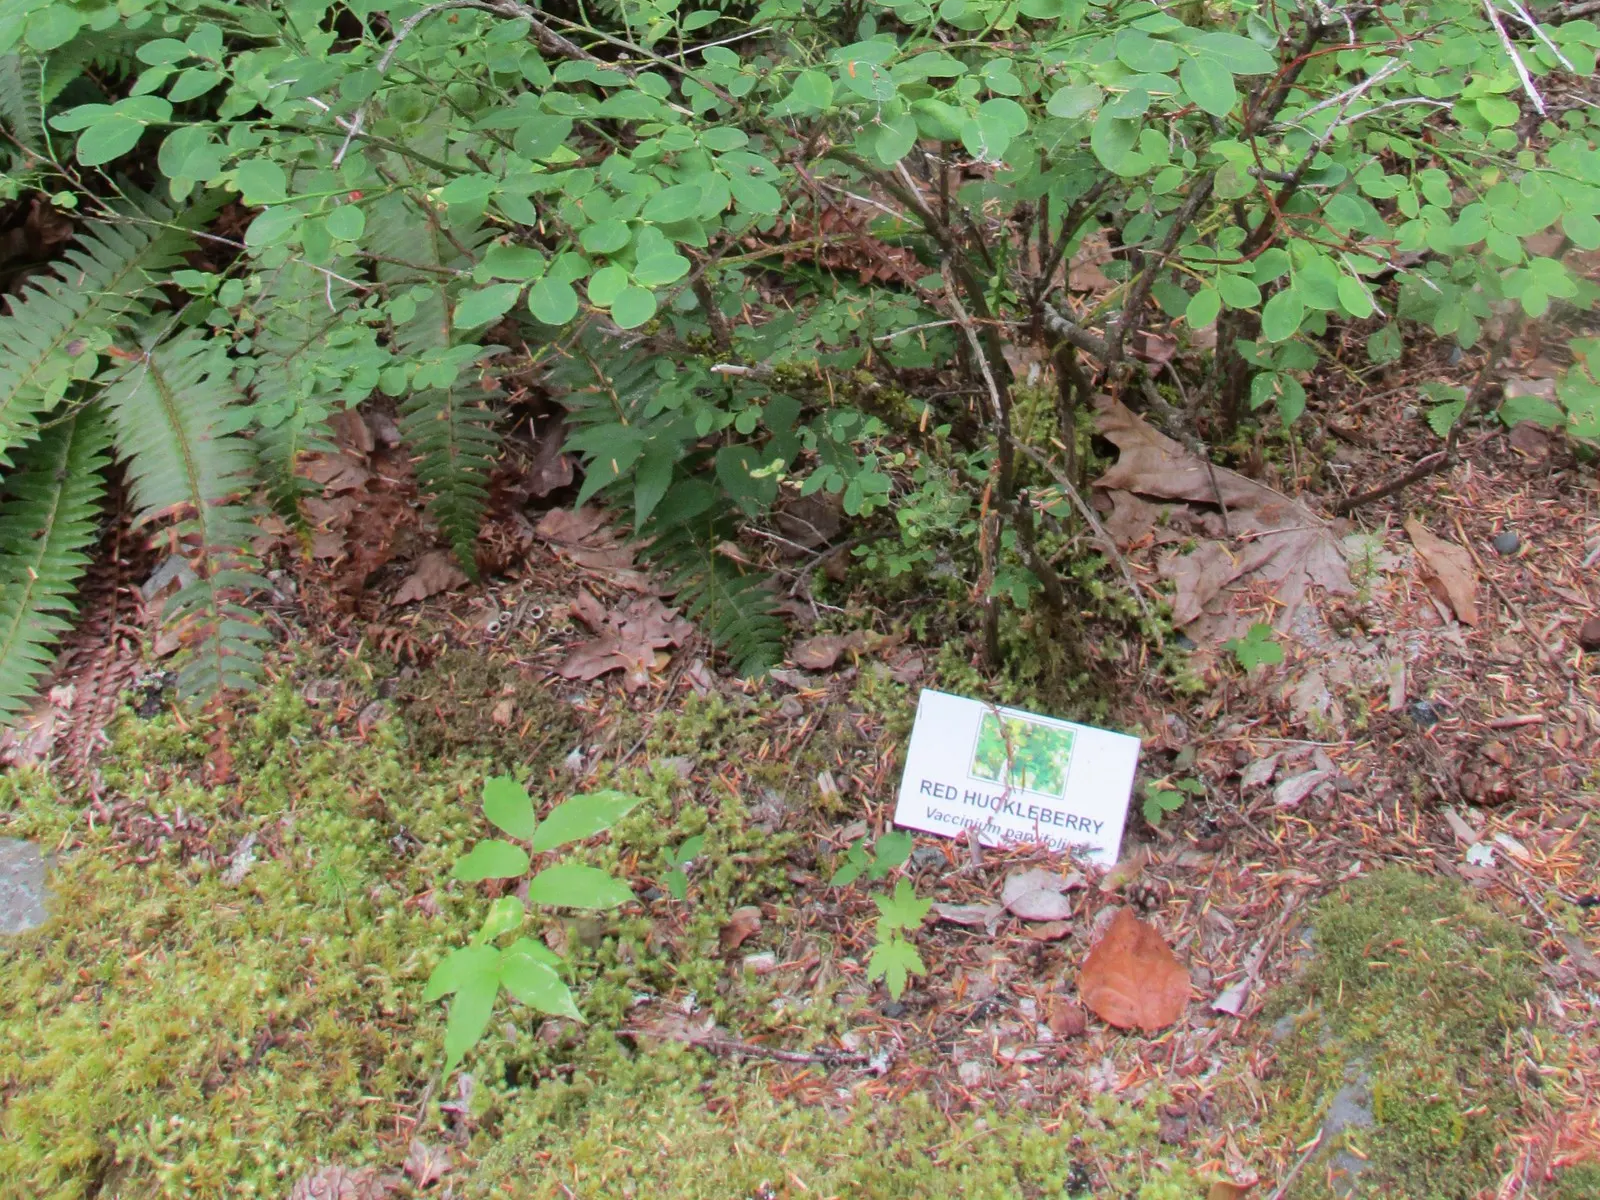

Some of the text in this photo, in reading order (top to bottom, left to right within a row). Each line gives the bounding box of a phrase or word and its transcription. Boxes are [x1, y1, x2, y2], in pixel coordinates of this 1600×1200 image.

[920, 779, 1104, 835] RED HUCKLEBERRY
[926, 806, 1001, 835] Vaccinium
